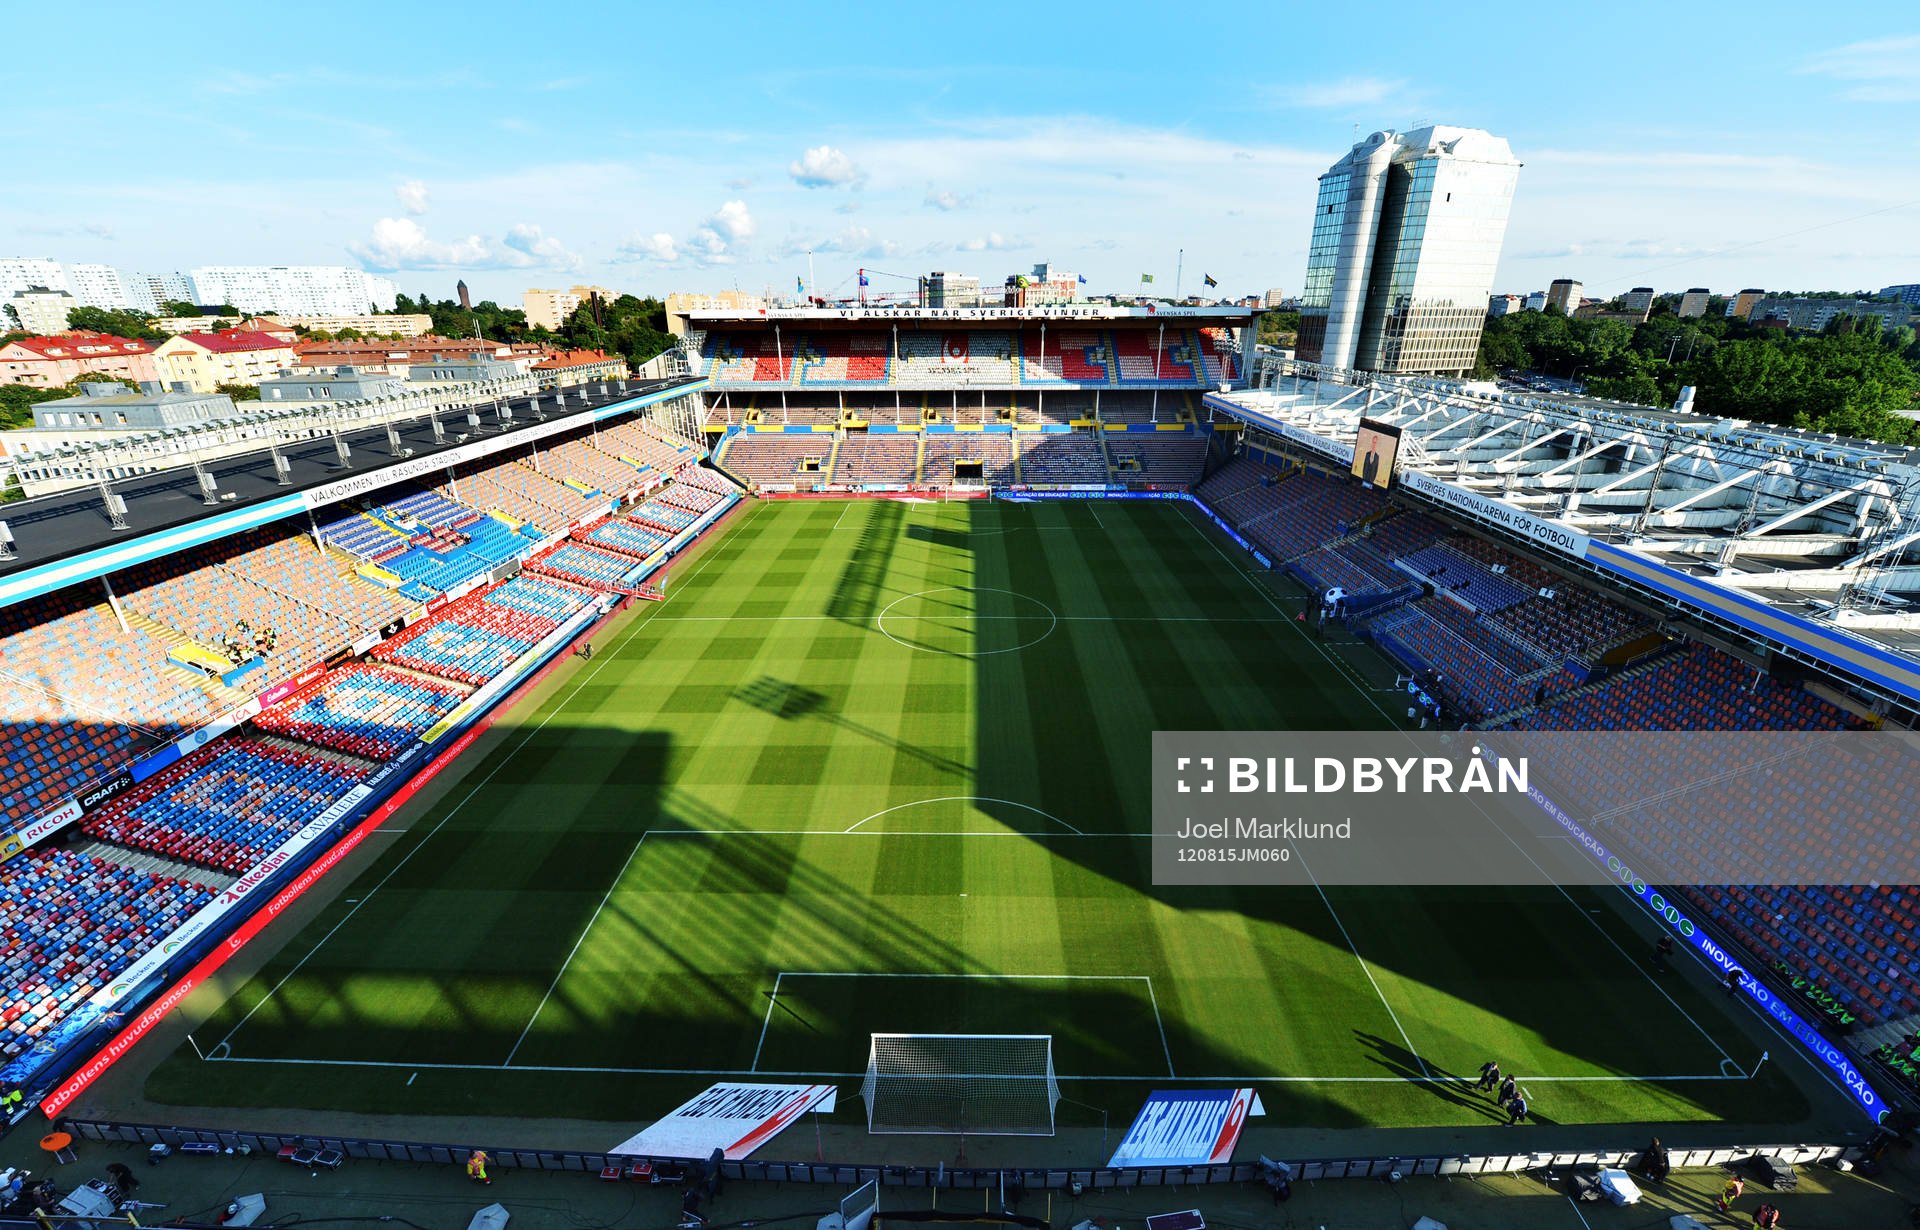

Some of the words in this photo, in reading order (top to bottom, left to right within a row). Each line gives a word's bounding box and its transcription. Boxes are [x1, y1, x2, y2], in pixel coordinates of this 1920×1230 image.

[840, 309, 854, 317] VI
[970, 309, 1034, 317] SVERIGE
[1043, 309, 1100, 317] VINNER
[375, 470, 391, 485] TILL
[432, 451, 463, 469] STADION
[1416, 478, 1446, 498] SVERIGES
[1447, 490, 1510, 525] NATIONALARENA
[1513, 515, 1532, 533] FÖR
[1533, 524, 1576, 551] FOTBOLL
[231, 708, 251, 724] ICA
[410, 764, 440, 790] Fotbollens
[439, 733, 475, 766] huvudsponsor
[83, 780, 120, 807] CRAFT
[26, 807, 75, 840] RICOH
[300, 790, 364, 841] CAVALIERE
[1543, 801, 1557, 816] EM
[1556, 811, 1605, 858] EDUCAÇÃO
[267, 875, 313, 915] Fotbollens
[177, 921, 204, 942] Beckers
[126, 960, 156, 984] Beckers
[109, 979, 194, 1057] huvudsponsor
[1769, 1001, 1793, 1026] EM
[1794, 1022, 1875, 1106] EDUCAÇÃO
[708, 1087, 801, 1121] SVENSKA
[1113, 1099, 1230, 1160] STRYKTIPSET
